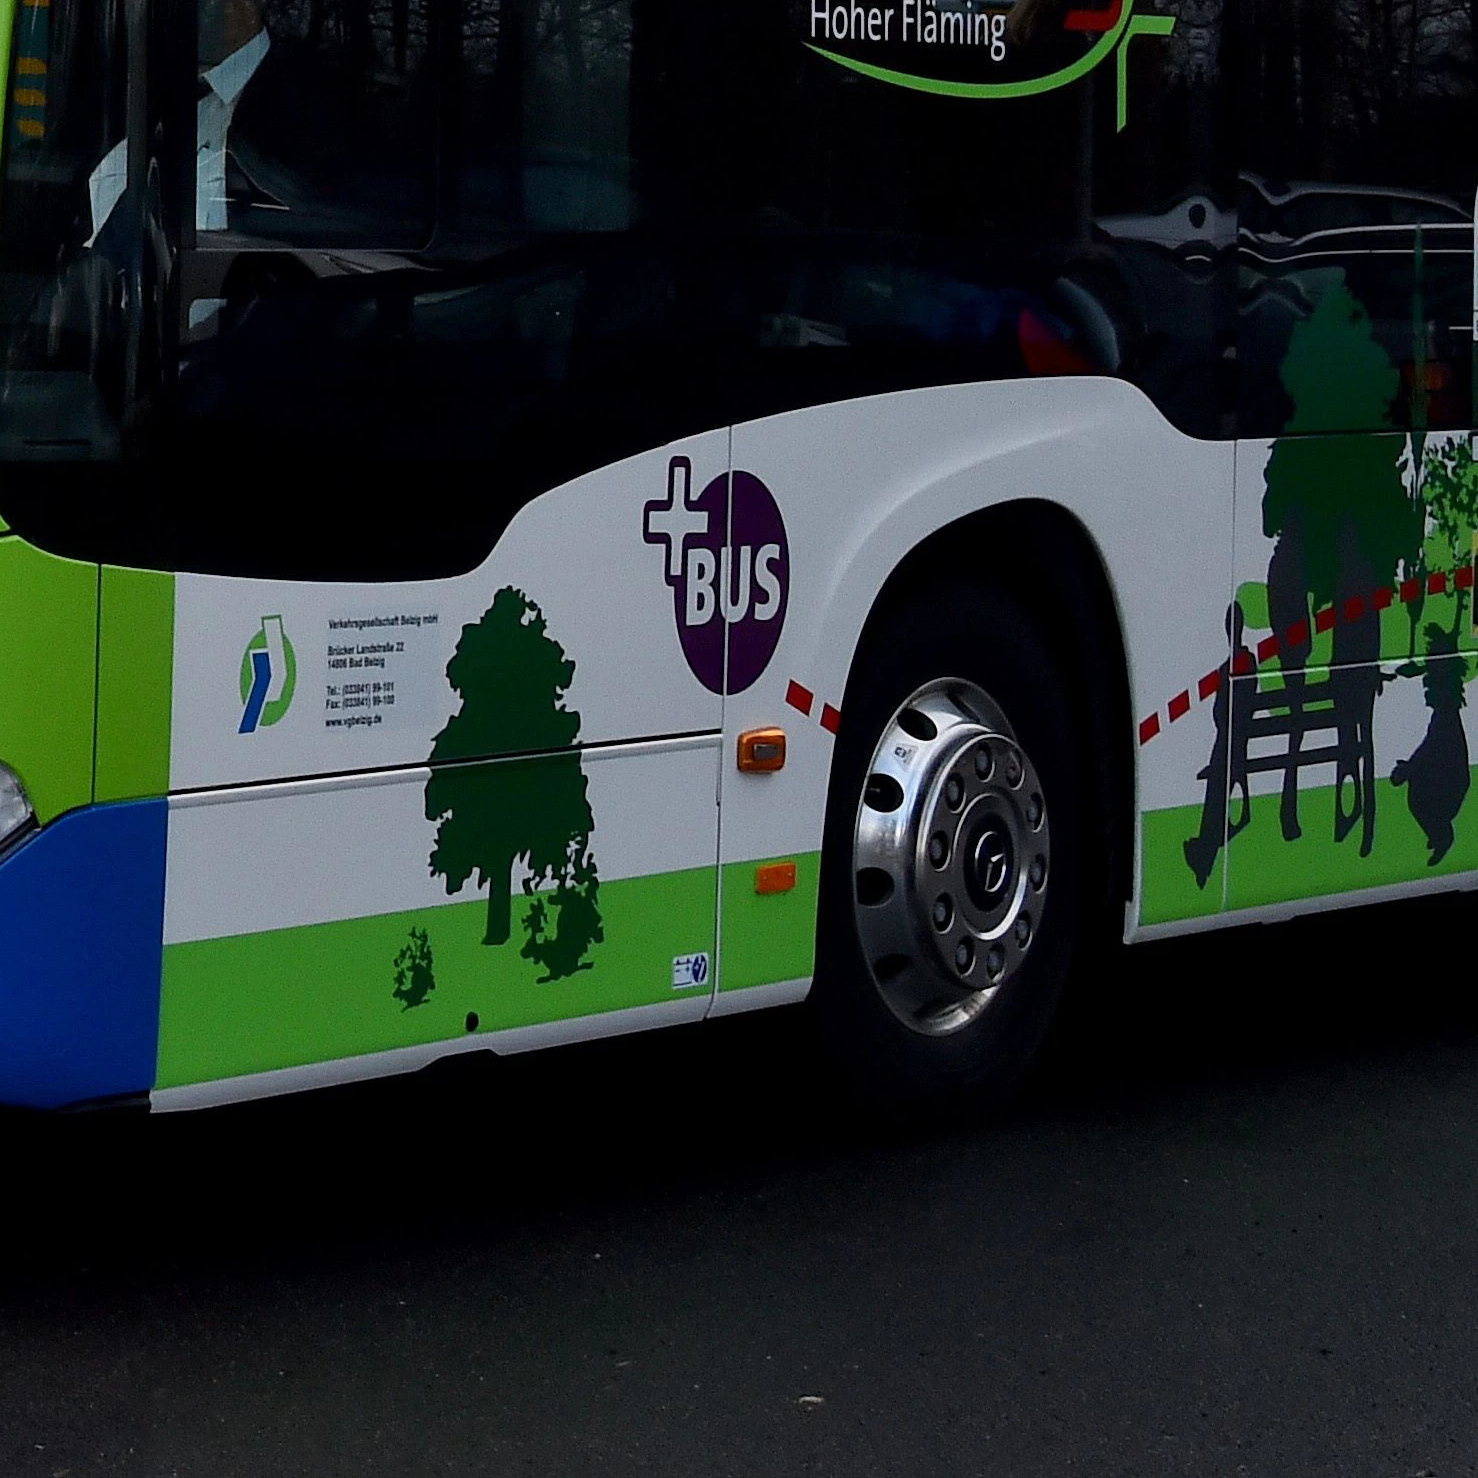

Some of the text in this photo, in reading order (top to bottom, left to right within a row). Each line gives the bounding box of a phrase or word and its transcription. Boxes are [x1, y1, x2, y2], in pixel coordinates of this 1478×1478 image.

[686, 543, 781, 626] BUS
[349, 656, 363, 668] Bad
[364, 656, 386, 669] Belzig
